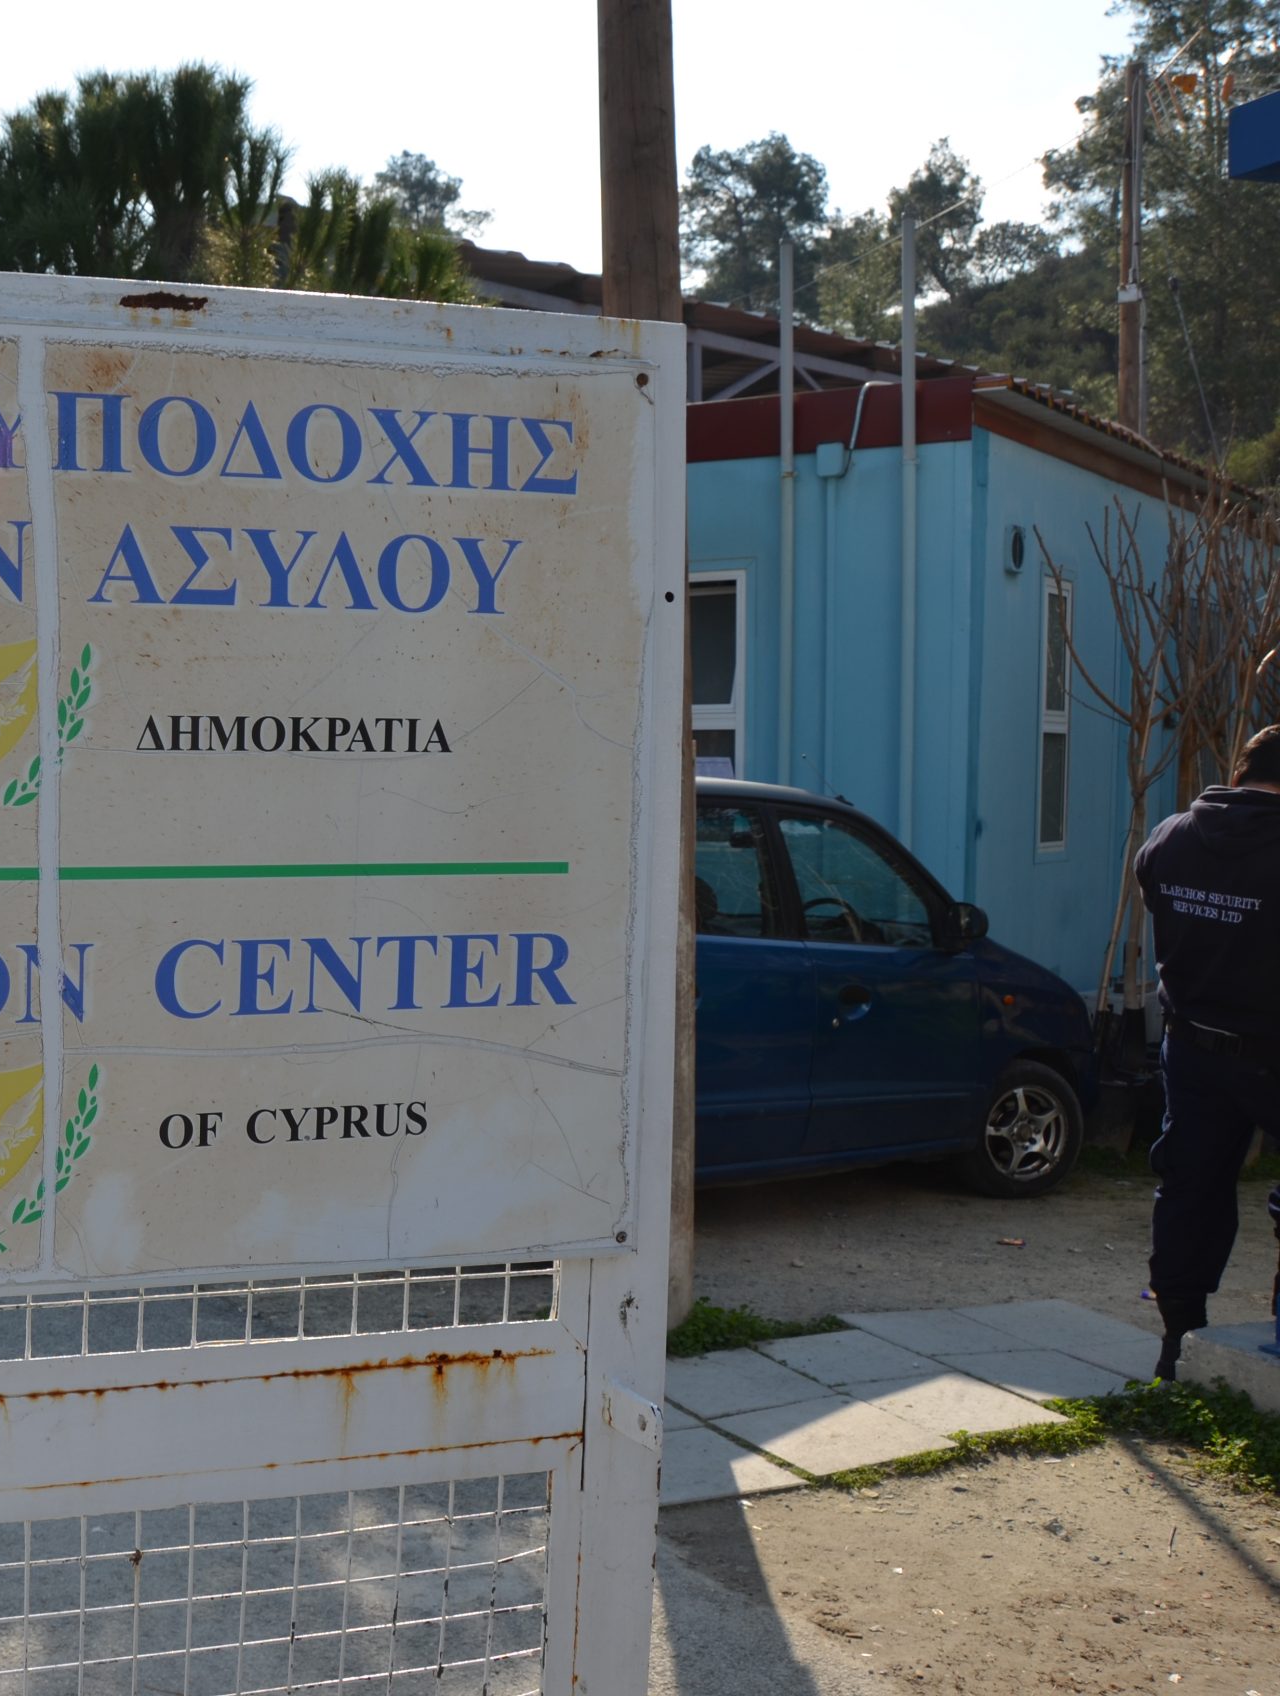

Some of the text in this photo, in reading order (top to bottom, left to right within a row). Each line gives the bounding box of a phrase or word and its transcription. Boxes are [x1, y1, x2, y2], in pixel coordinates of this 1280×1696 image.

[87, 523, 523, 615] ΑΣΥΛΟΥ
[136, 714, 453, 753] ΔΗΜΟΚΡΑΤΙΑ
[1172, 900, 1242, 924] SERVICES LTD
[1208, 892, 1262, 911] SECURITY
[154, 932, 575, 1019] CENTER
[158, 1112, 224, 1149] OF
[246, 1101, 429, 1144] CYPRUS
